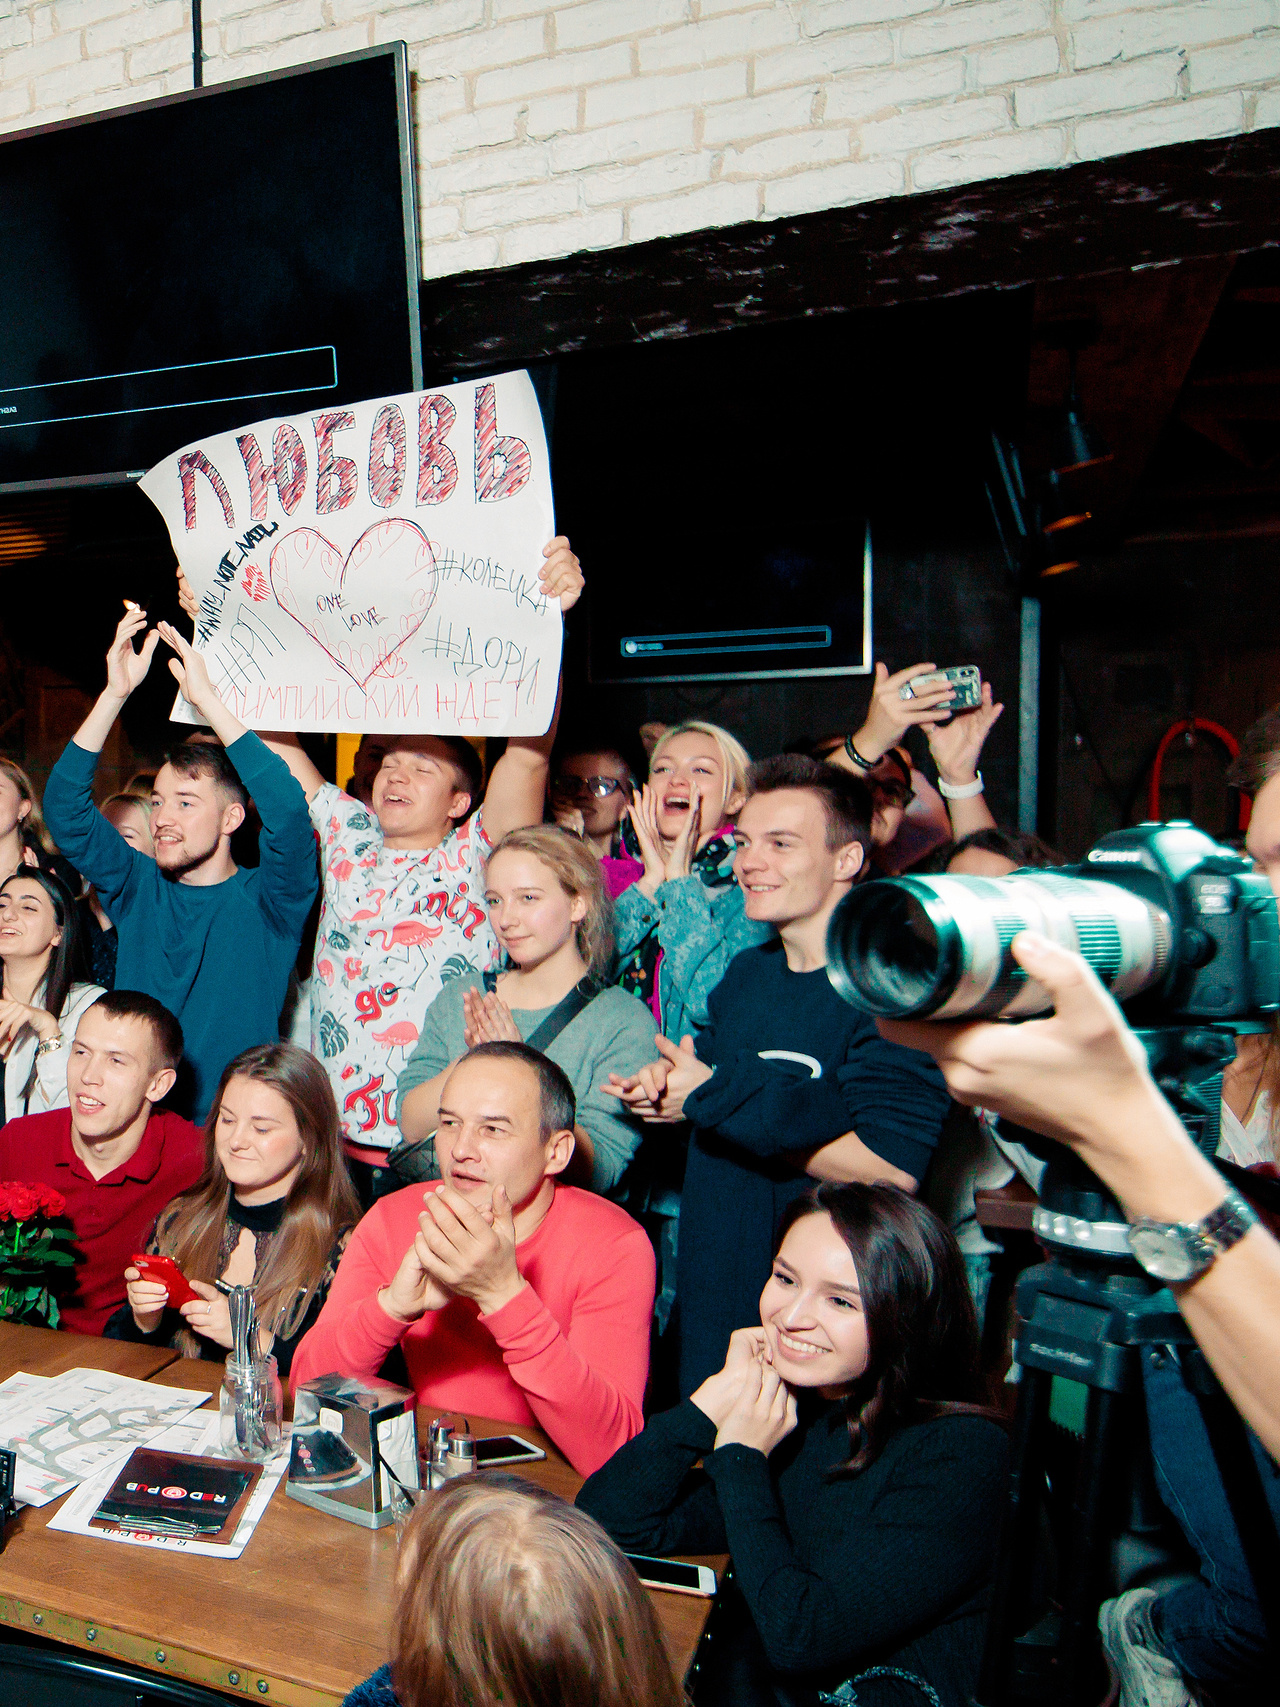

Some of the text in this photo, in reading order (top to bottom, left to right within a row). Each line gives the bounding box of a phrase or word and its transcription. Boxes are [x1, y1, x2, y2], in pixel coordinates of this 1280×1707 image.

[177, 383, 532, 533] ЛЮБОВЬ
[316, 592, 351, 615] ONE
[341, 605, 390, 633] LOVE
[1087, 850, 1142, 863] Canon
[354, 982, 400, 1029] go
[125, 1482, 227, 1504] RED PUB
